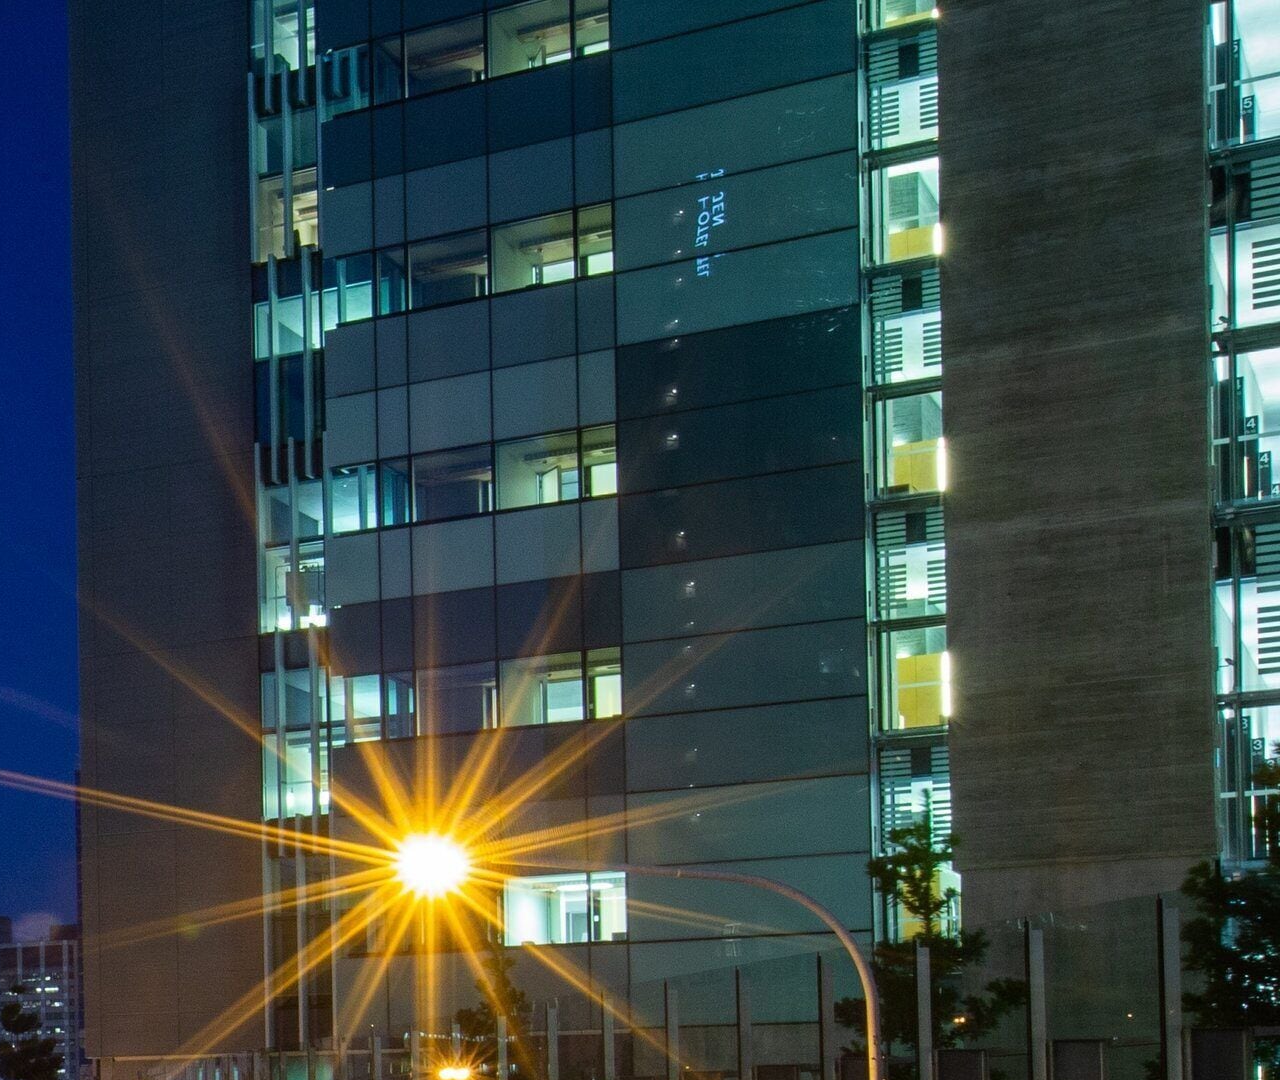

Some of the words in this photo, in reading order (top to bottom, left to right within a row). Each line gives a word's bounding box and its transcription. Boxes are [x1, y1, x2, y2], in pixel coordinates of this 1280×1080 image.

[1243, 97, 1253, 109] 5
[1246, 417, 1256, 429] 4
[1259, 453, 1270, 464] 4
[1252, 739, 1263, 751] 3
